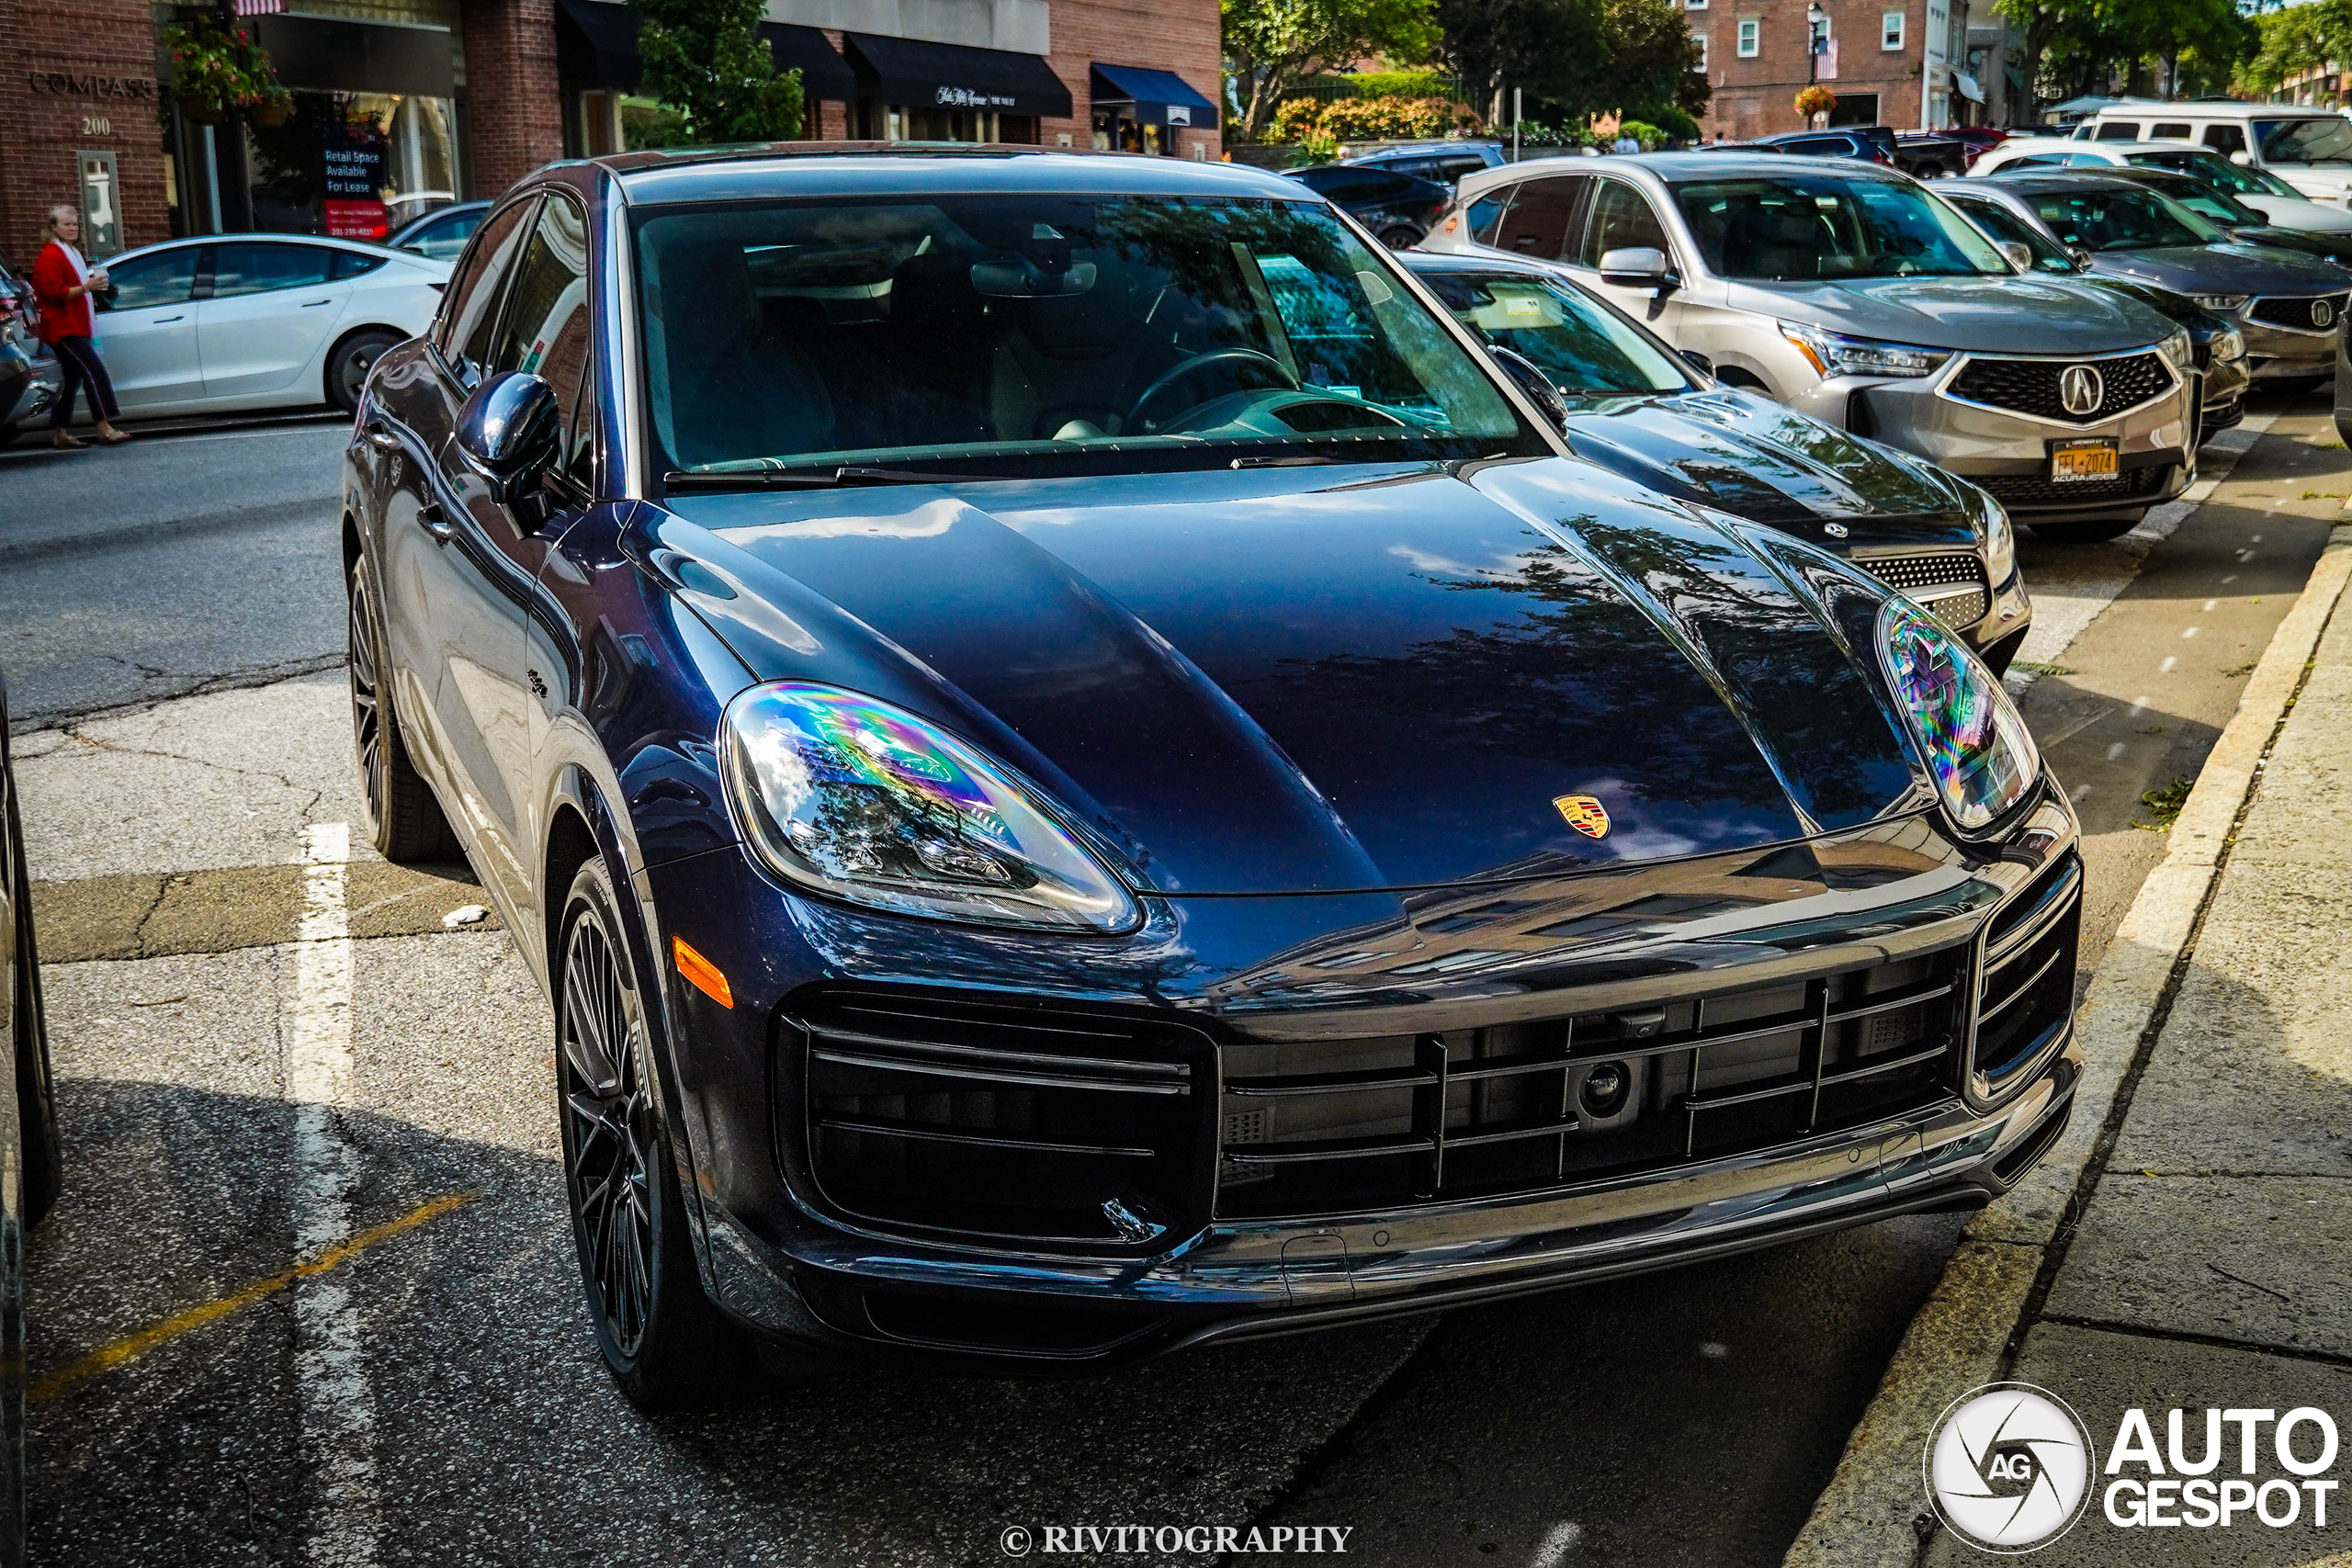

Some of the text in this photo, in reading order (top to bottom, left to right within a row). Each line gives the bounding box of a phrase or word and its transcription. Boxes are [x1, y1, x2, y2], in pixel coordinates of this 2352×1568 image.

[31, 72, 153, 99] COMPASS
[82, 116, 111, 136] 200
[325, 151, 379, 165] Retail Space
[327, 165, 367, 177] Available
[328, 182, 369, 193] For Lease
[2086, 453, 2111, 472] 2074
[630, 1020, 653, 1111] PIRELLI
